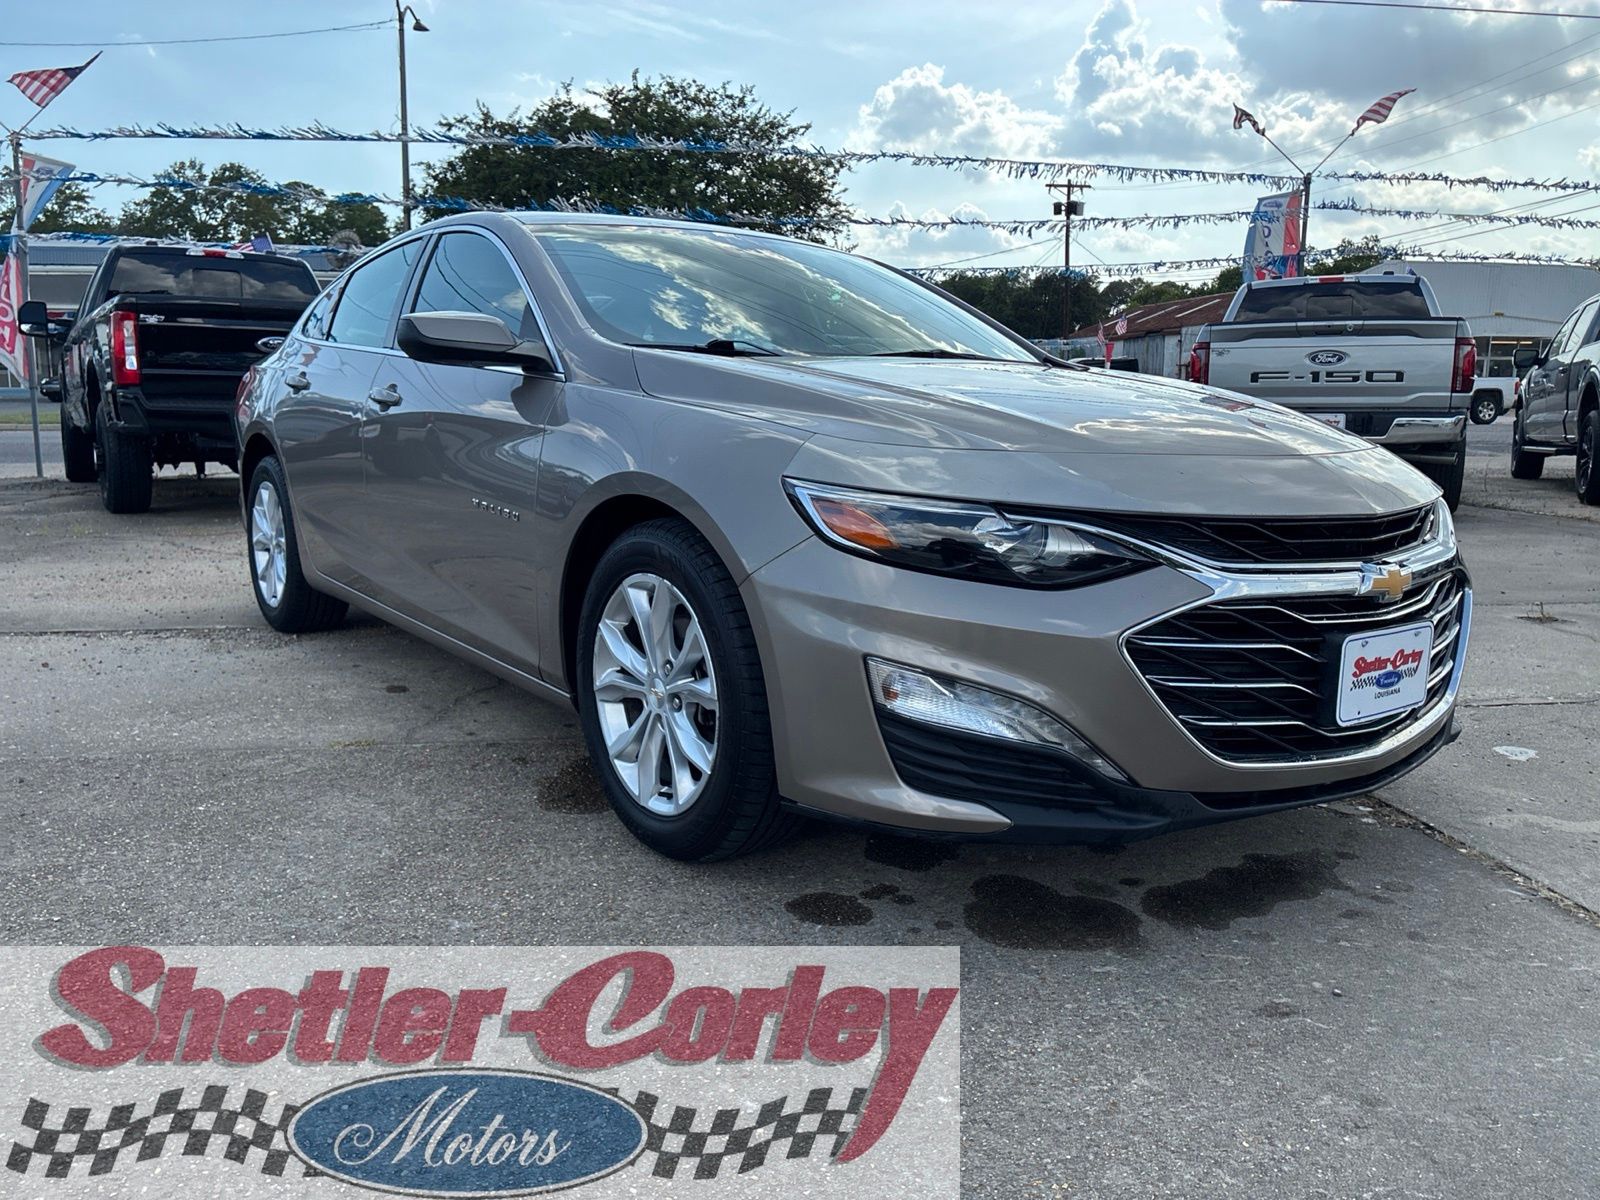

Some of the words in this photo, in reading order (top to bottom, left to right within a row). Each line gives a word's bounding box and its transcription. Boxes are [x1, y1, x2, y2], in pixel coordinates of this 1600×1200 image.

[1315, 352, 1339, 363] Ford
[1249, 370, 1405, 384] F-150
[1374, 688, 1401, 699] LOUISIANA
